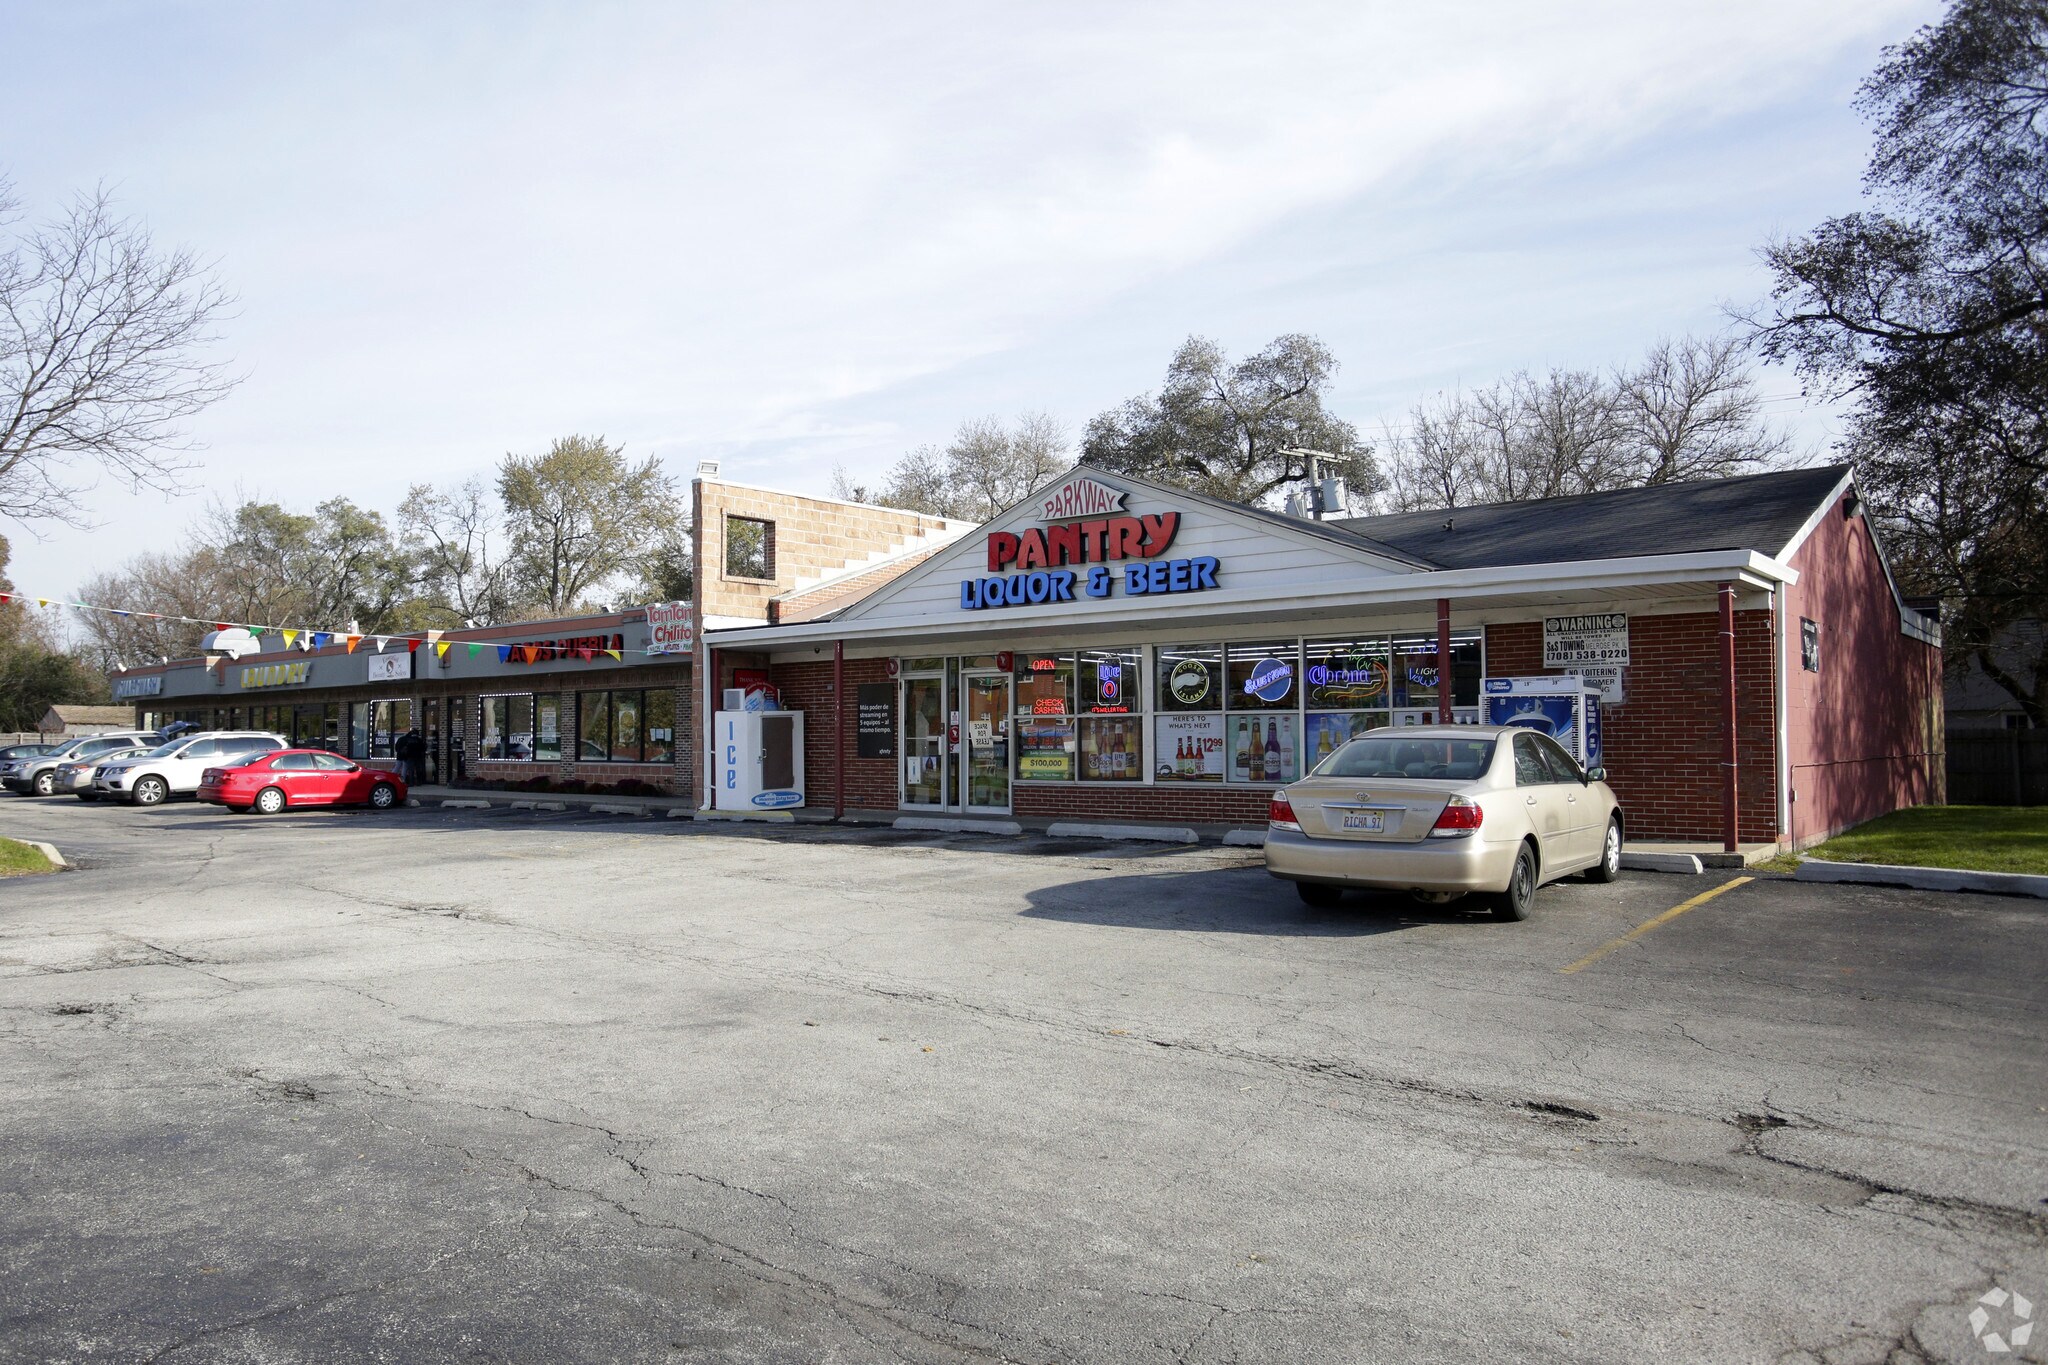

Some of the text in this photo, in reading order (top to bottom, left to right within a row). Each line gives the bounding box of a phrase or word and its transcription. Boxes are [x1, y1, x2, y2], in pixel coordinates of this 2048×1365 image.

[1044, 480, 1116, 518] PARKWAY
[988, 511, 1181, 572] PANTRY
[961, 555, 1220, 610] LIQUOR & BEER
[1560, 615, 1612, 631] WARNING
[558, 634, 624, 659] PUEBLA
[1546, 640, 1585, 652] S&S TOWING
[1576, 649, 1627, 660] 538-0220
[1032, 659, 1055, 671] OPEN
[1178, 662, 1201, 673] GOOSE
[1415, 667, 1439, 675] LIGH
[241, 662, 310, 688] LAUNDRY
[1308, 665, 1368, 686] Corona
[1581, 667, 1617, 677] LOITERING
[1178, 689, 1204, 700] ISLAND
[1036, 699, 1063, 707] CHECK
[1030, 759, 1062, 768] $100,000
[1344, 817, 1381, 829] RICHA 97
